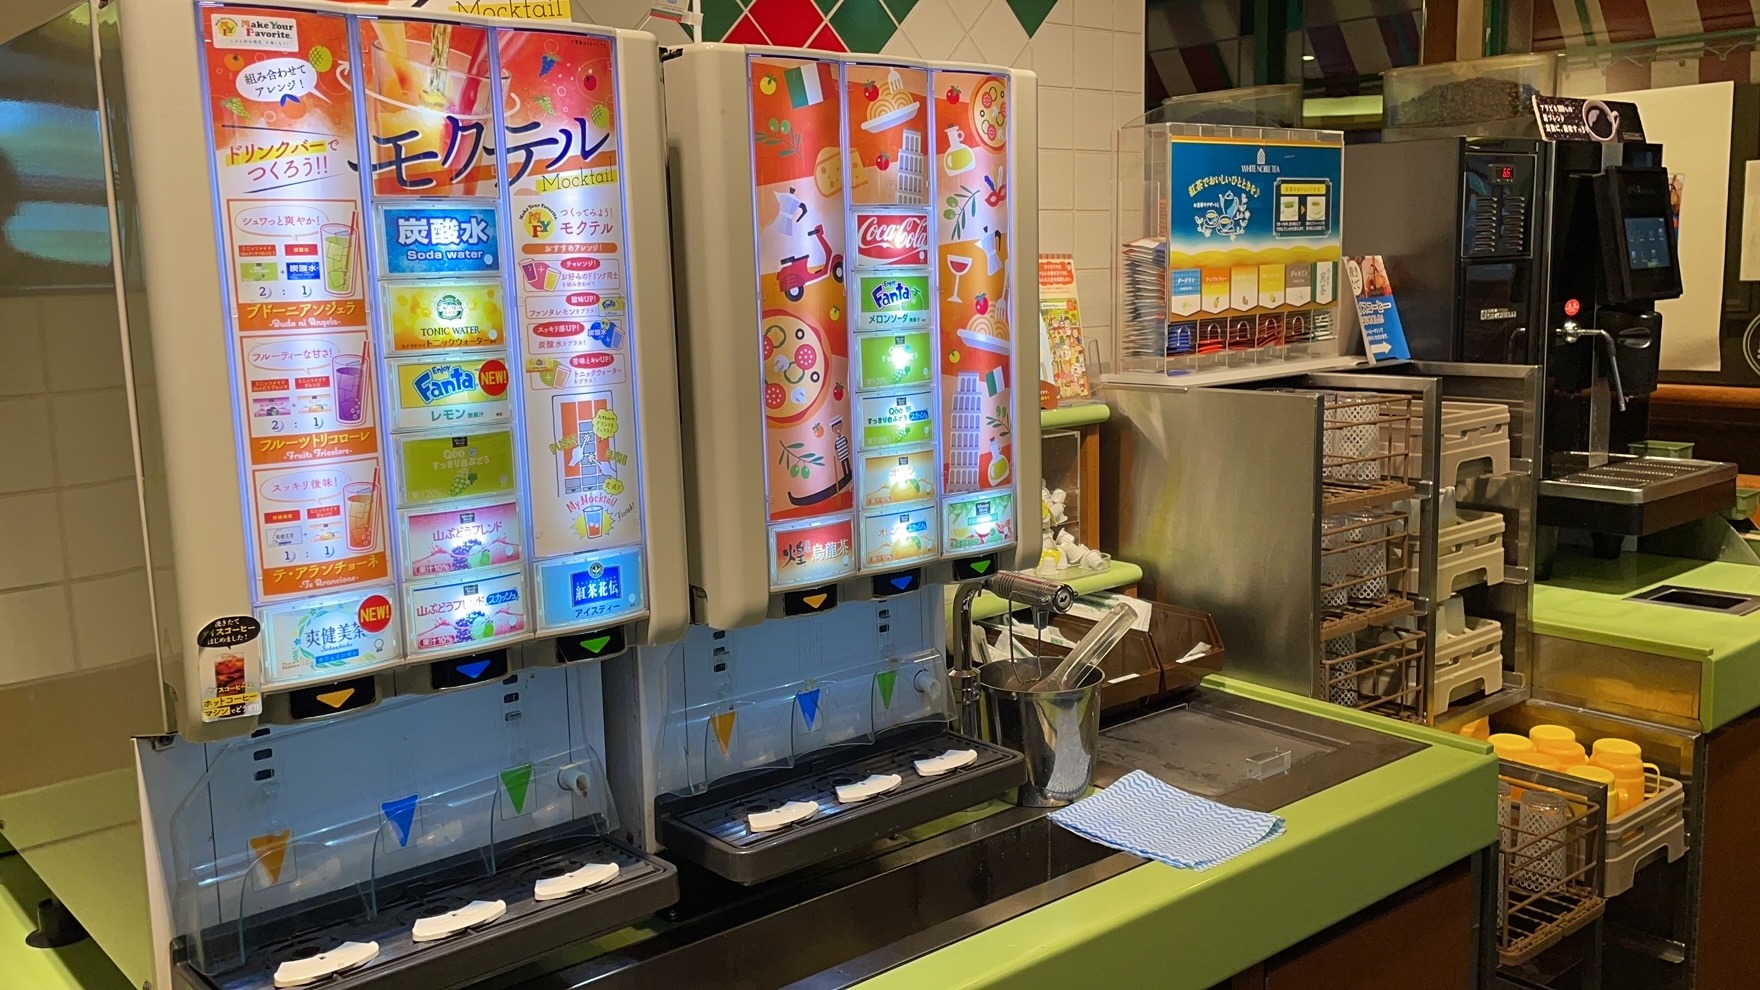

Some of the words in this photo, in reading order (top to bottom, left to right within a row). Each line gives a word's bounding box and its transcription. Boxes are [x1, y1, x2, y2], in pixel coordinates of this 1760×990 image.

[457, 0, 563, 20] Mocktail
[241, 19, 269, 29] Make
[270, 21, 294, 31] Your
[244, 65, 306, 85] 組み合わせて
[228, 139, 340, 165] ドリンクバーで
[348, 115, 610, 188] モクテル
[541, 157, 614, 192] Mocktail
[1241, 165, 1257, 173] WHITE
[1271, 165, 1280, 173] TEA
[560, 207, 614, 218] つくってみよう!
[242, 215, 320, 226] シュワっと爽やか!
[398, 218, 489, 245] 炭酸水
[560, 220, 614, 236] モクテル
[407, 250, 442, 260] Soda
[446, 250, 483, 259] water
[545, 244, 602, 253] おすすめアレンジ!
[259, 287, 267, 297] 2
[871, 283, 911, 310] Fanta
[247, 301, 356, 319] ブドーニアンジェラ
[869, 314, 908, 324] メロンソーダ
[421, 327, 450, 337] TONIC
[451, 325, 480, 335] WATER
[252, 348, 333, 362] フルーティーな甘さ!
[432, 364, 451, 375] Enjoy
[574, 369, 622, 379] トニックウォーター
[413, 367, 476, 402] Fanta
[480, 370, 508, 386] NEW!
[431, 409, 466, 421] レモン
[271, 420, 279, 430] 2
[260, 431, 370, 452] フルーツトリコローレ
[443, 450, 465, 460] Qoo
[432, 456, 490, 470] すっきり白ぶどう
[272, 477, 338, 493] スッキリ後味!
[580, 493, 618, 508] Mocktail
[811, 539, 849, 562] 烏龍茶
[273, 556, 379, 583] テ・アランチョーネ
[488, 590, 517, 604] スカッシュ
[575, 580, 619, 602] 紅茶花伝
[360, 605, 390, 623] NEW!
[575, 604, 620, 618] アイスティー
[203, 625, 256, 637] アイスコーヒー
[304, 621, 367, 648] 爽健美茶
[207, 634, 248, 645] はじめました!
[203, 693, 258, 707] ホットコーヒー
